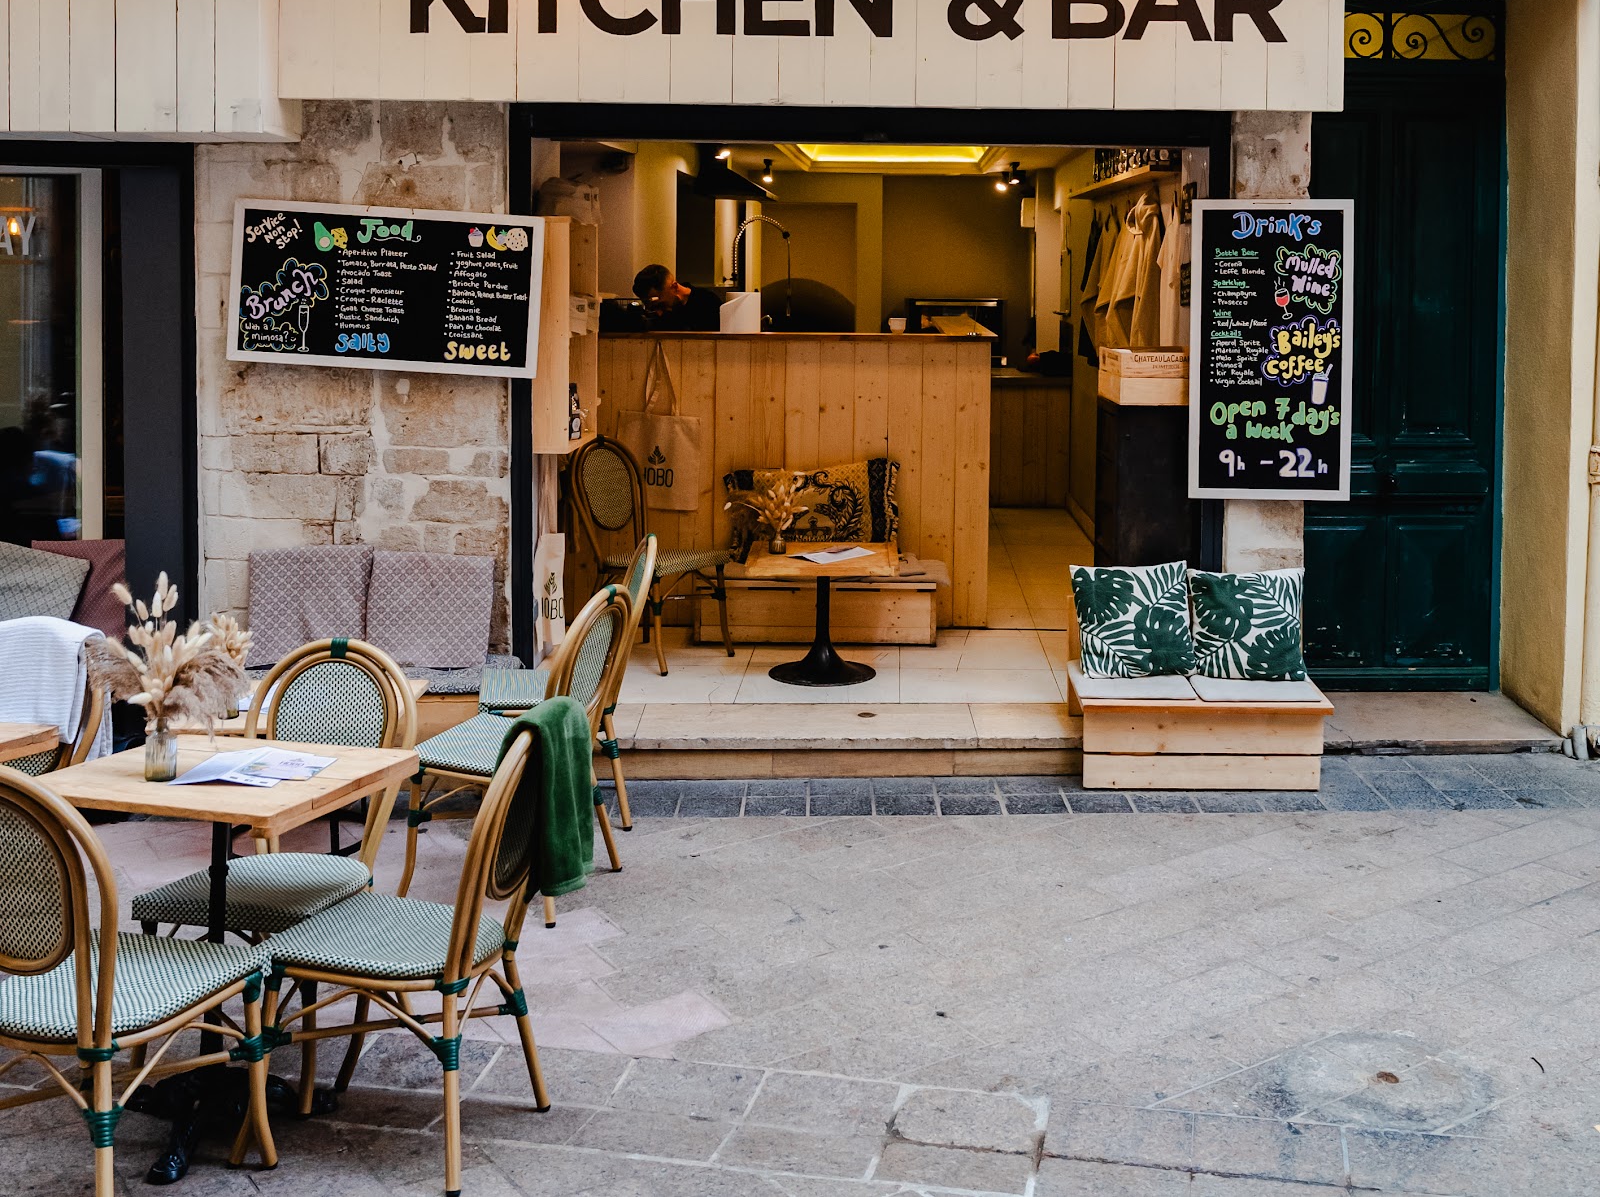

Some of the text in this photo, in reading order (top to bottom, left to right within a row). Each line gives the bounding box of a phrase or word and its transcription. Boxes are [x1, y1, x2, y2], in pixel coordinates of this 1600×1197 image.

[264, 225, 286, 244] Non
[357, 219, 413, 243] Food
[476, 251, 496, 259] Salad
[418, 263, 438, 272] Salad
[341, 269, 392, 278] Avocado Toast
[452, 280, 480, 289] Brioche
[1291, 275, 1331, 296] Wine
[246, 269, 319, 319] Brunch
[451, 298, 475, 306] Cookie
[450, 306, 481, 314] Brownie
[364, 314, 400, 325] Sandwich
[449, 314, 498, 323] Banana Bread
[339, 322, 371, 330] Hummus
[448, 331, 484, 340] Croissant
[1210, 401, 1266, 425] Open
[1274, 398, 1290, 420] 7
[1226, 424, 1238, 440] a
